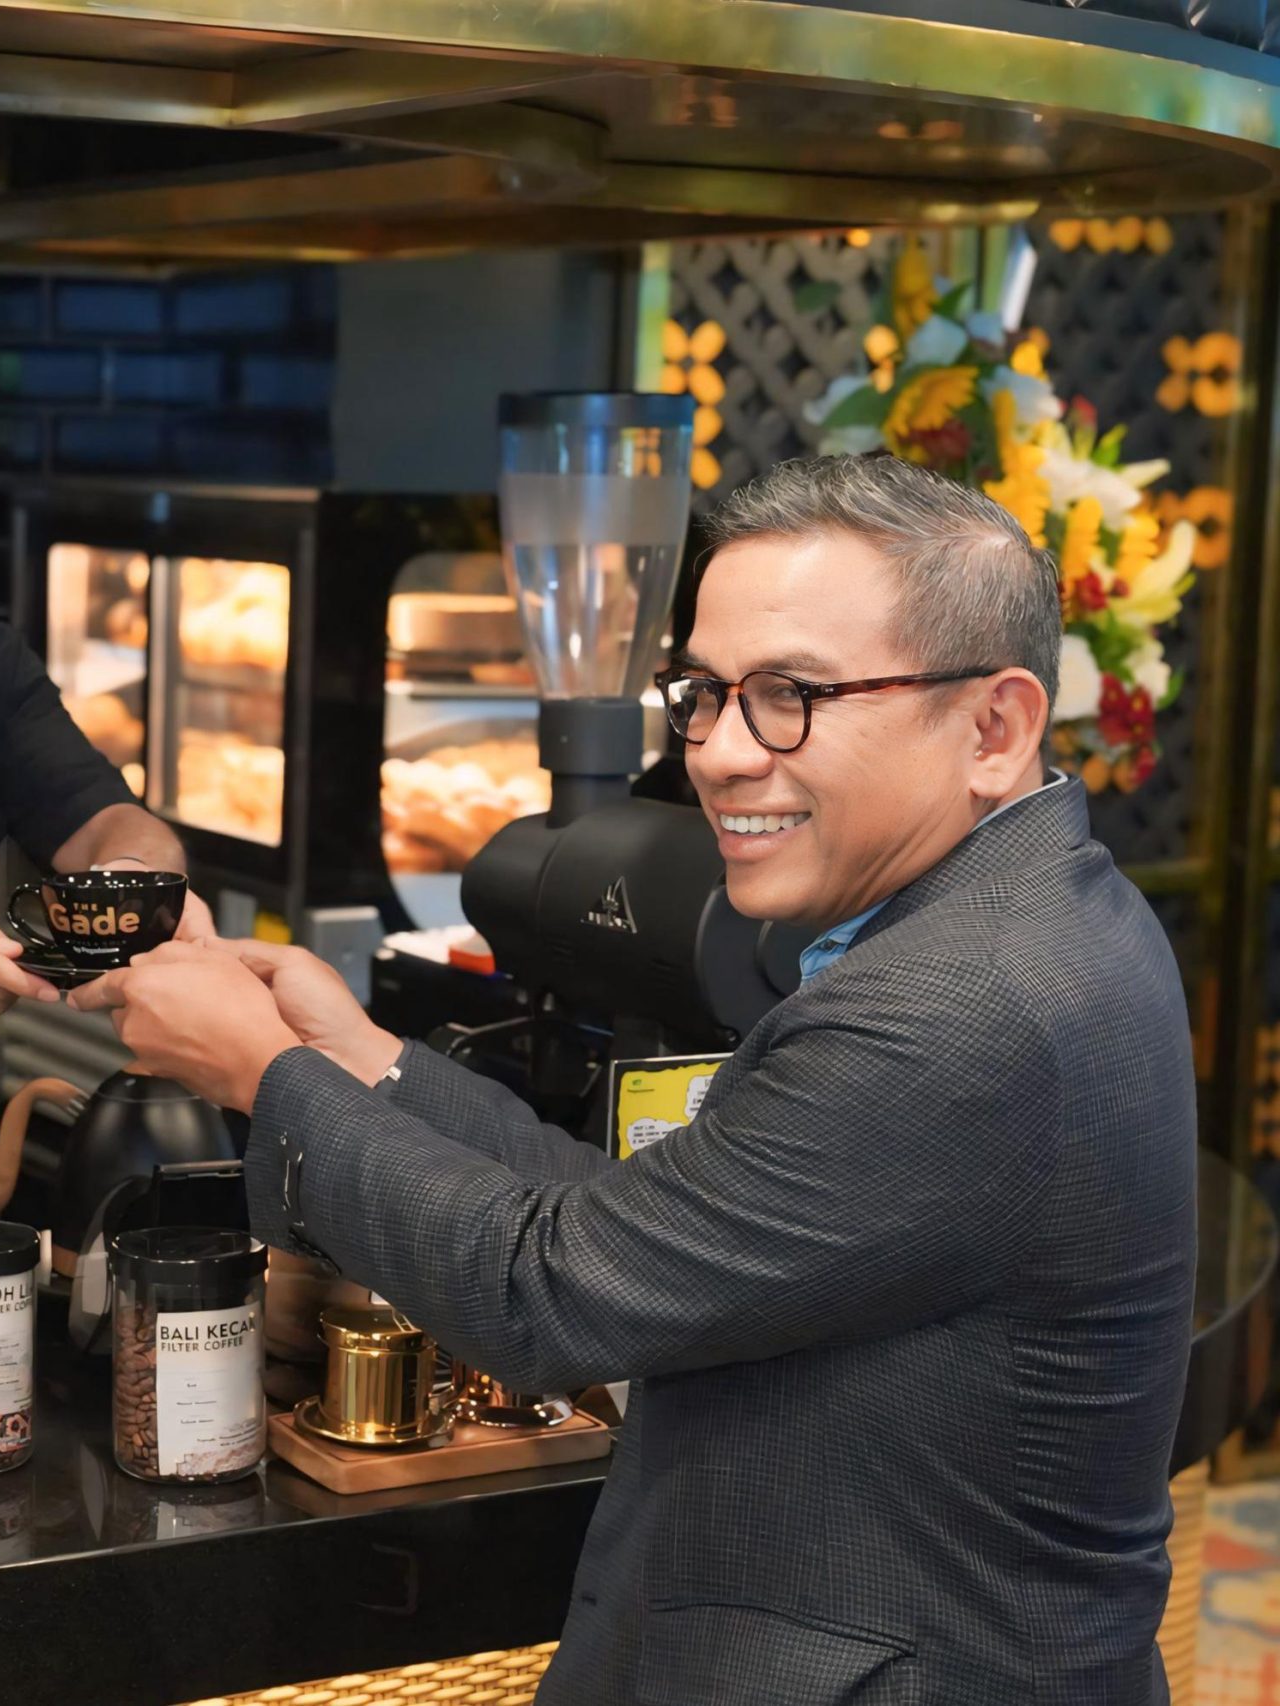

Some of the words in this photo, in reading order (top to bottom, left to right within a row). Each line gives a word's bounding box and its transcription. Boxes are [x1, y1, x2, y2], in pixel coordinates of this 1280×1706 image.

[72, 902, 98, 912] THE
[48, 903, 140, 936] Gade
[160, 1325, 199, 1341] BALI
[160, 1341, 200, 1353] FILTER
[203, 1335, 243, 1351] COFFEE
